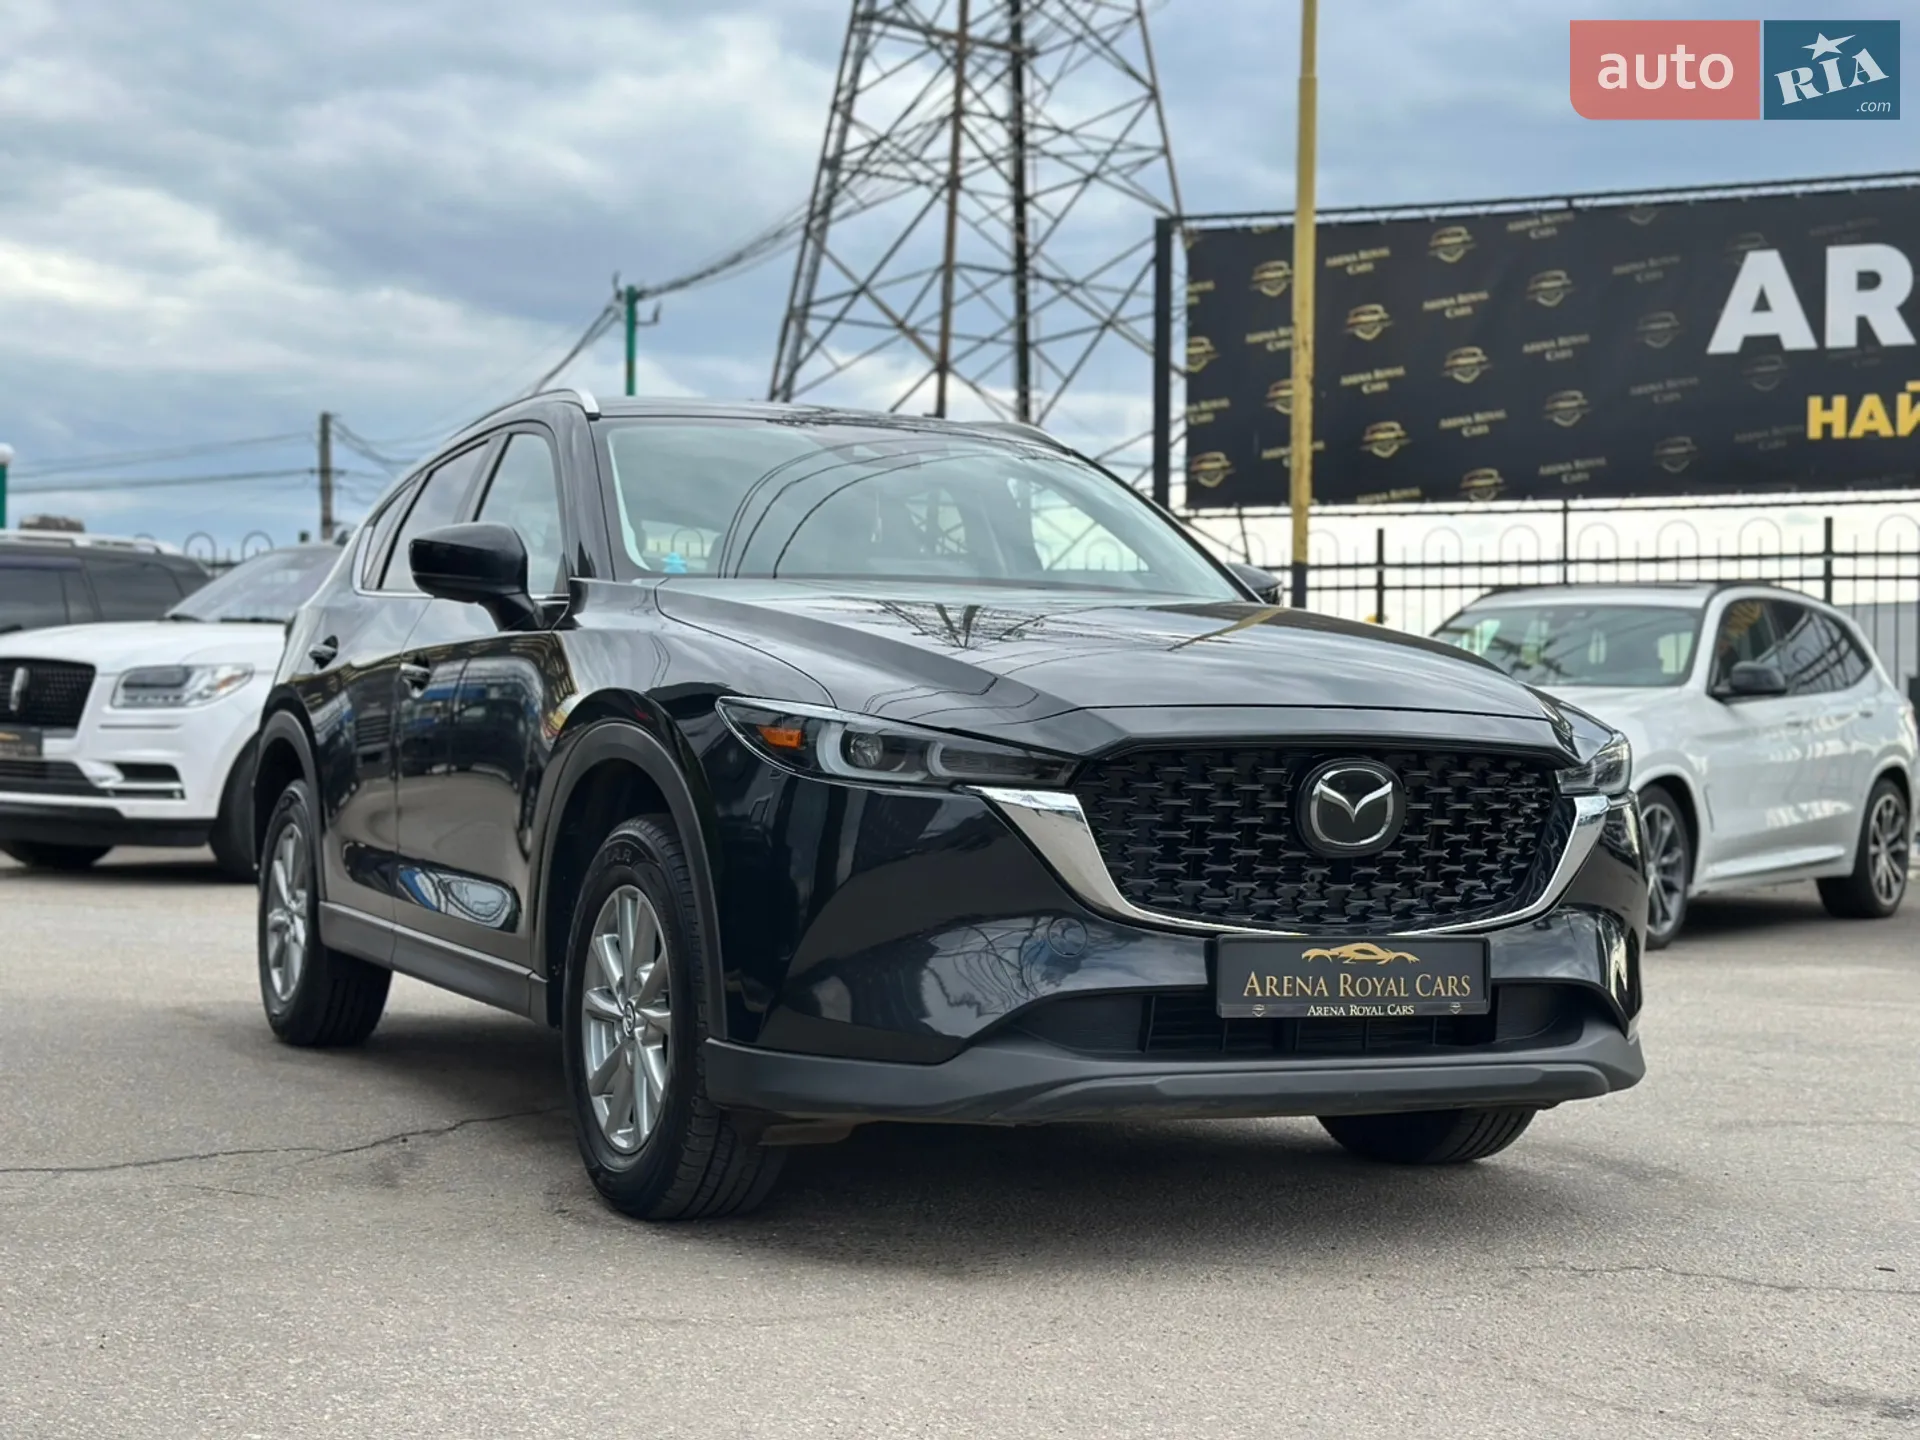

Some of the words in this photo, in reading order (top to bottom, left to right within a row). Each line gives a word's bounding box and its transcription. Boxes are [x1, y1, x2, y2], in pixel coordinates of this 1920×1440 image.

[1706, 243, 1917, 355] AR
[1243, 971, 1329, 997] ARENA
[1339, 972, 1410, 998] ROYAL
[1415, 973, 1471, 997] CARS
[1307, 1004, 1346, 1016] ARENA
[1349, 1003, 1385, 1016] ROYAL
[1387, 1003, 1415, 1016] CARS
